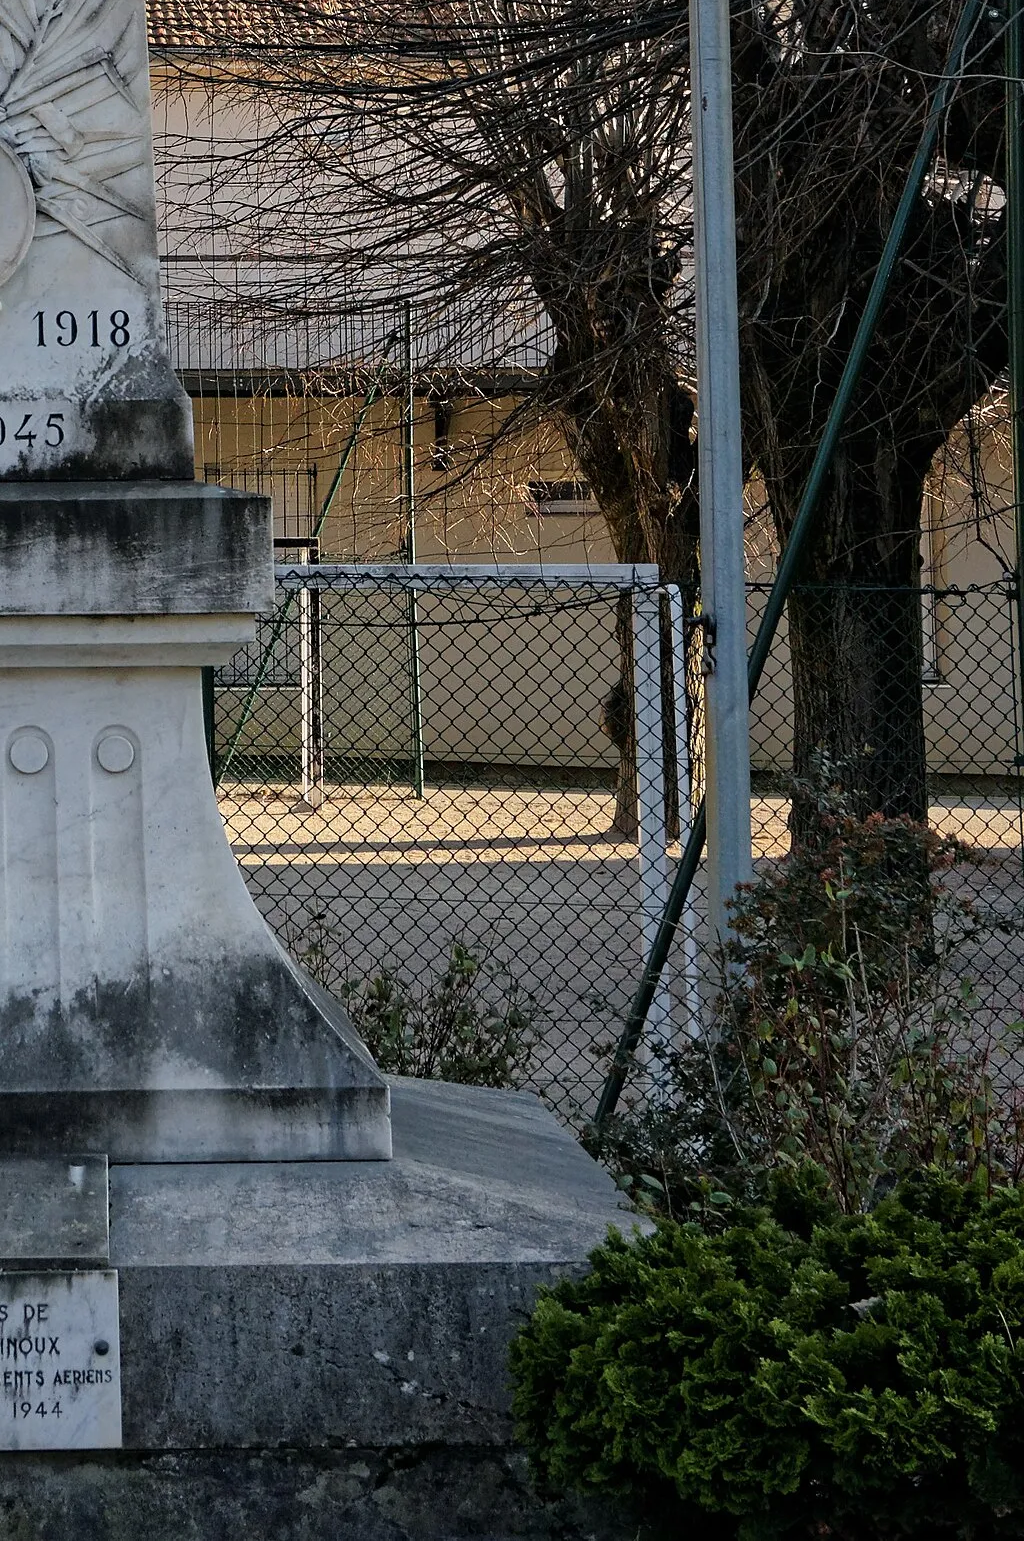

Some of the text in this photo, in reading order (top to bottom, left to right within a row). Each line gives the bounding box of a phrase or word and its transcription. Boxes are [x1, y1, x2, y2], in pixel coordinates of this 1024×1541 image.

[32, 309, 131, 348] 1918
[24, 1303, 49, 1323] DE
[53, 1370, 113, 1386] AERIENS
[12, 1402, 63, 1419] 1944
